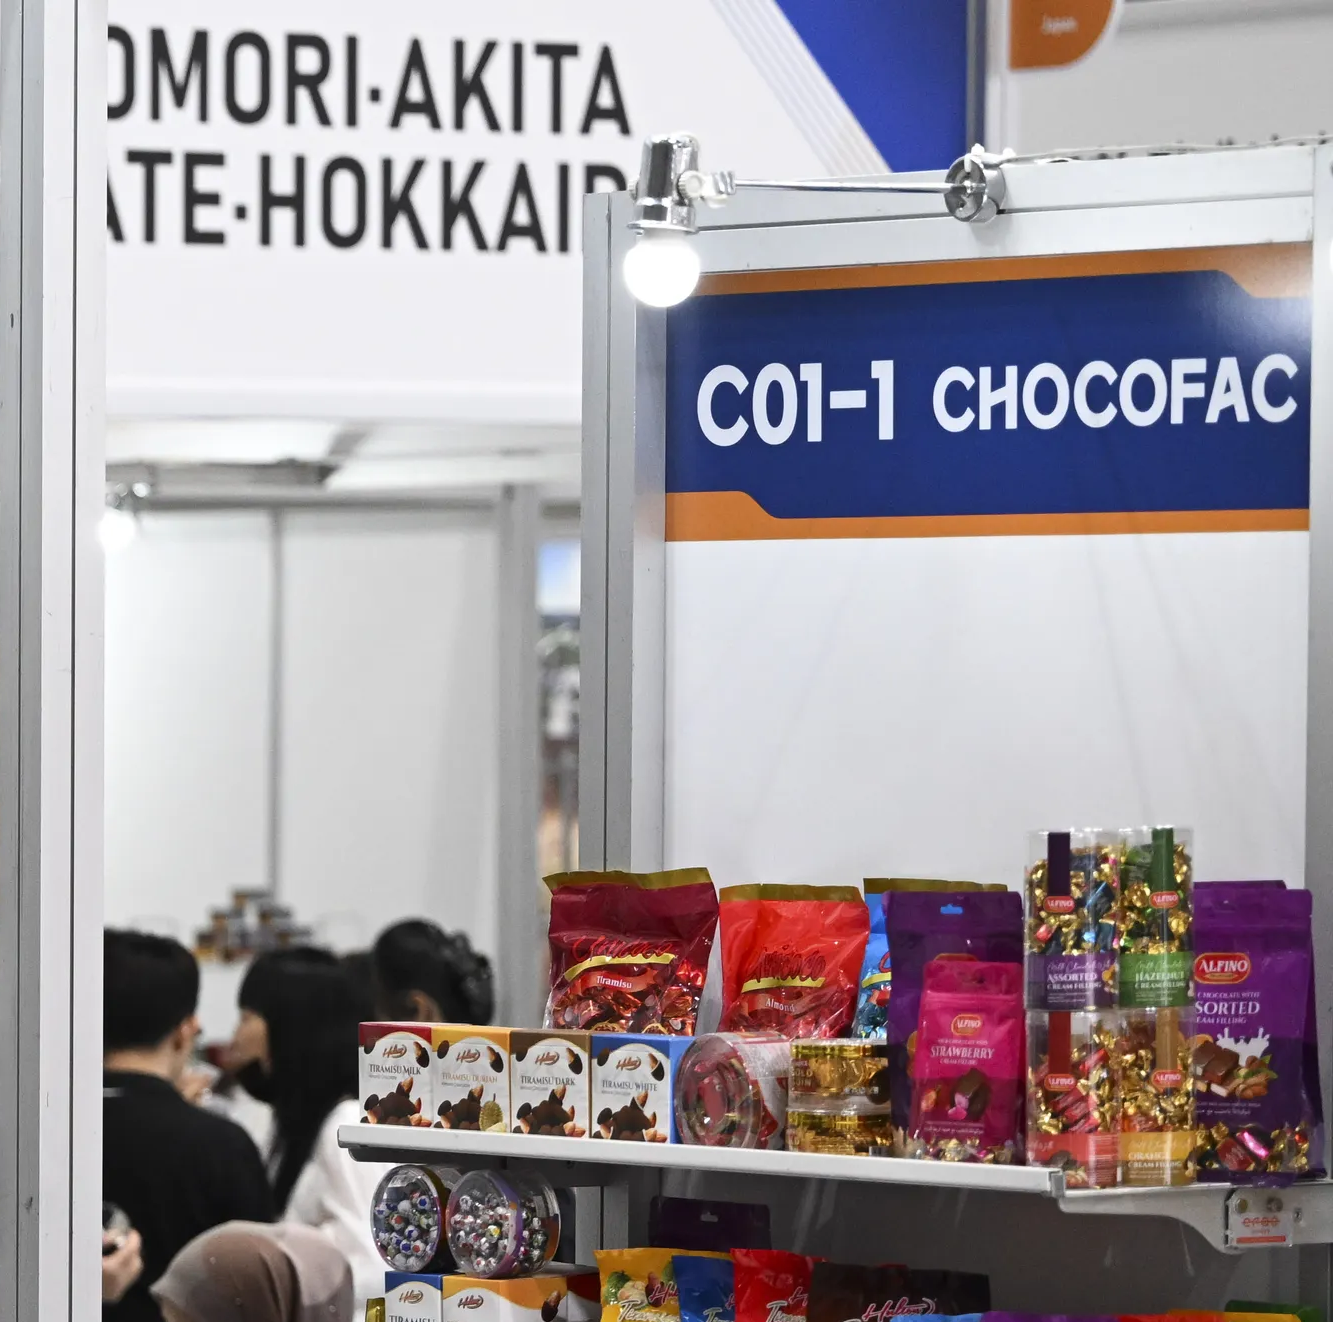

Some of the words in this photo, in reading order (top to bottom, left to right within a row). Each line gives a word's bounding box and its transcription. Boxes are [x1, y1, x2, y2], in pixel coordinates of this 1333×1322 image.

[697, 359, 895, 447] C01-1
[933, 353, 1299, 432] CHOCOFAC
[1199, 958, 1249, 973] ALFINO
[596, 975, 632, 989] Tiramisu
[1047, 972, 1097, 982] ASSORTED
[765, 997, 795, 1013] Almond
[930, 1046, 995, 1060] STRAWBERRY
[369, 1063, 401, 1075] TIRAMISU
[403, 1065, 421, 1076] MILK
[442, 1071, 472, 1082] TIRAMISU
[520, 1075, 554, 1085] TIRAMISU
[555, 1076, 576, 1086] DARK
[602, 1079, 633, 1090] TIRAMISU
[635, 1081, 658, 1092] WHITE
